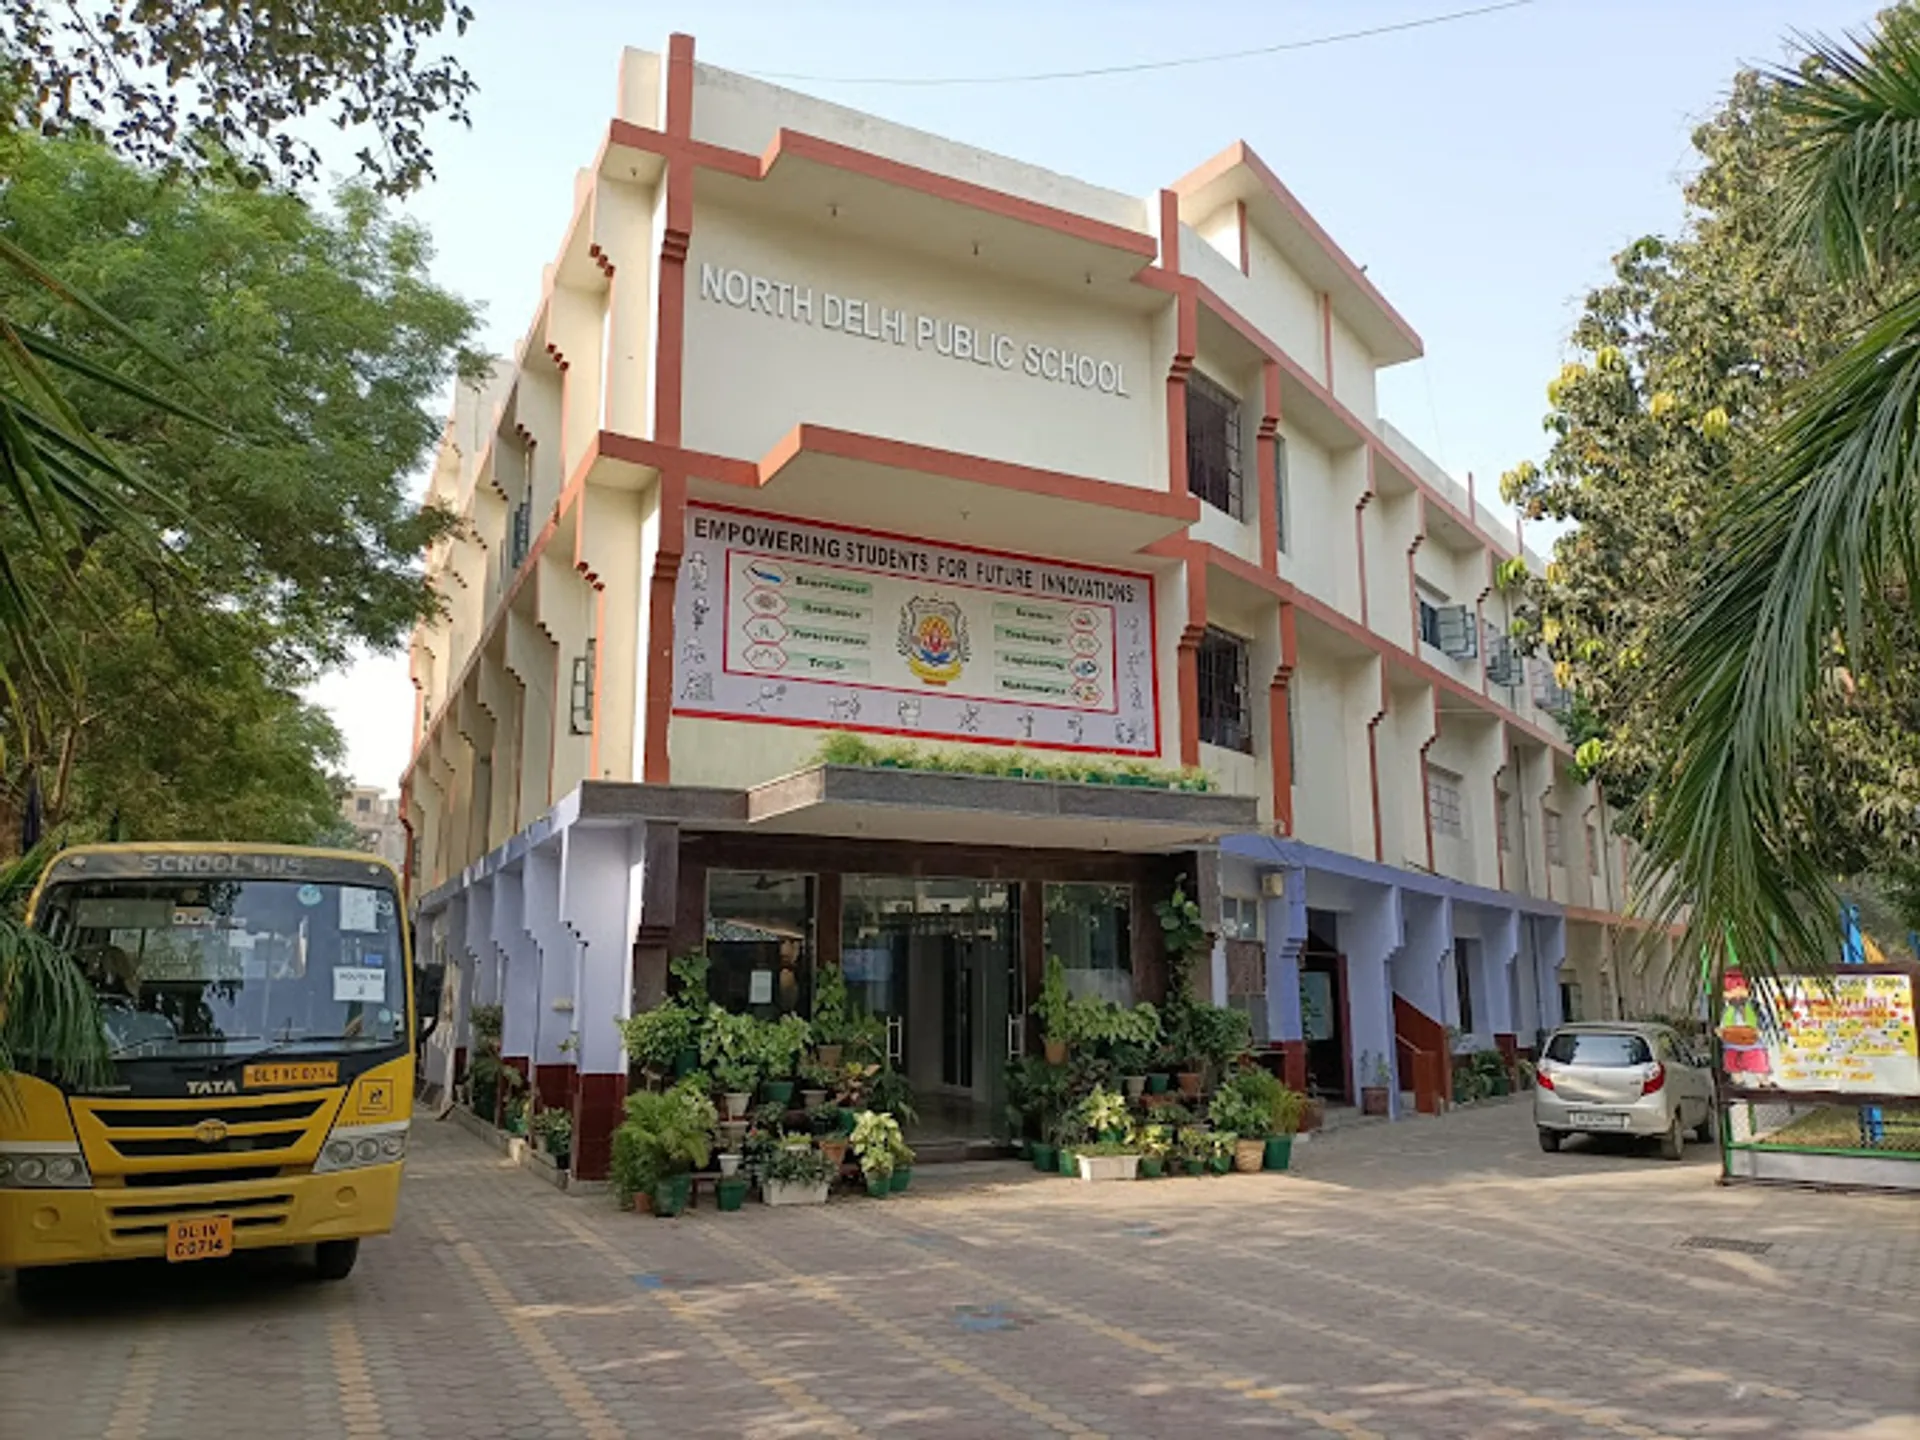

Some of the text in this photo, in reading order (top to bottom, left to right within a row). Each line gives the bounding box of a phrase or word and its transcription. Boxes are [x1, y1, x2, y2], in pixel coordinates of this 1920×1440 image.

[700, 262, 1130, 398] NORTH DELHI PUBLIC SCHOOL
[694, 516, 1136, 603] EMPOWERING STUDENTS FOR FUTURE INNOVATIONS
[141, 855, 244, 873] SCHOOL
[186, 1080, 237, 1095] TATA
